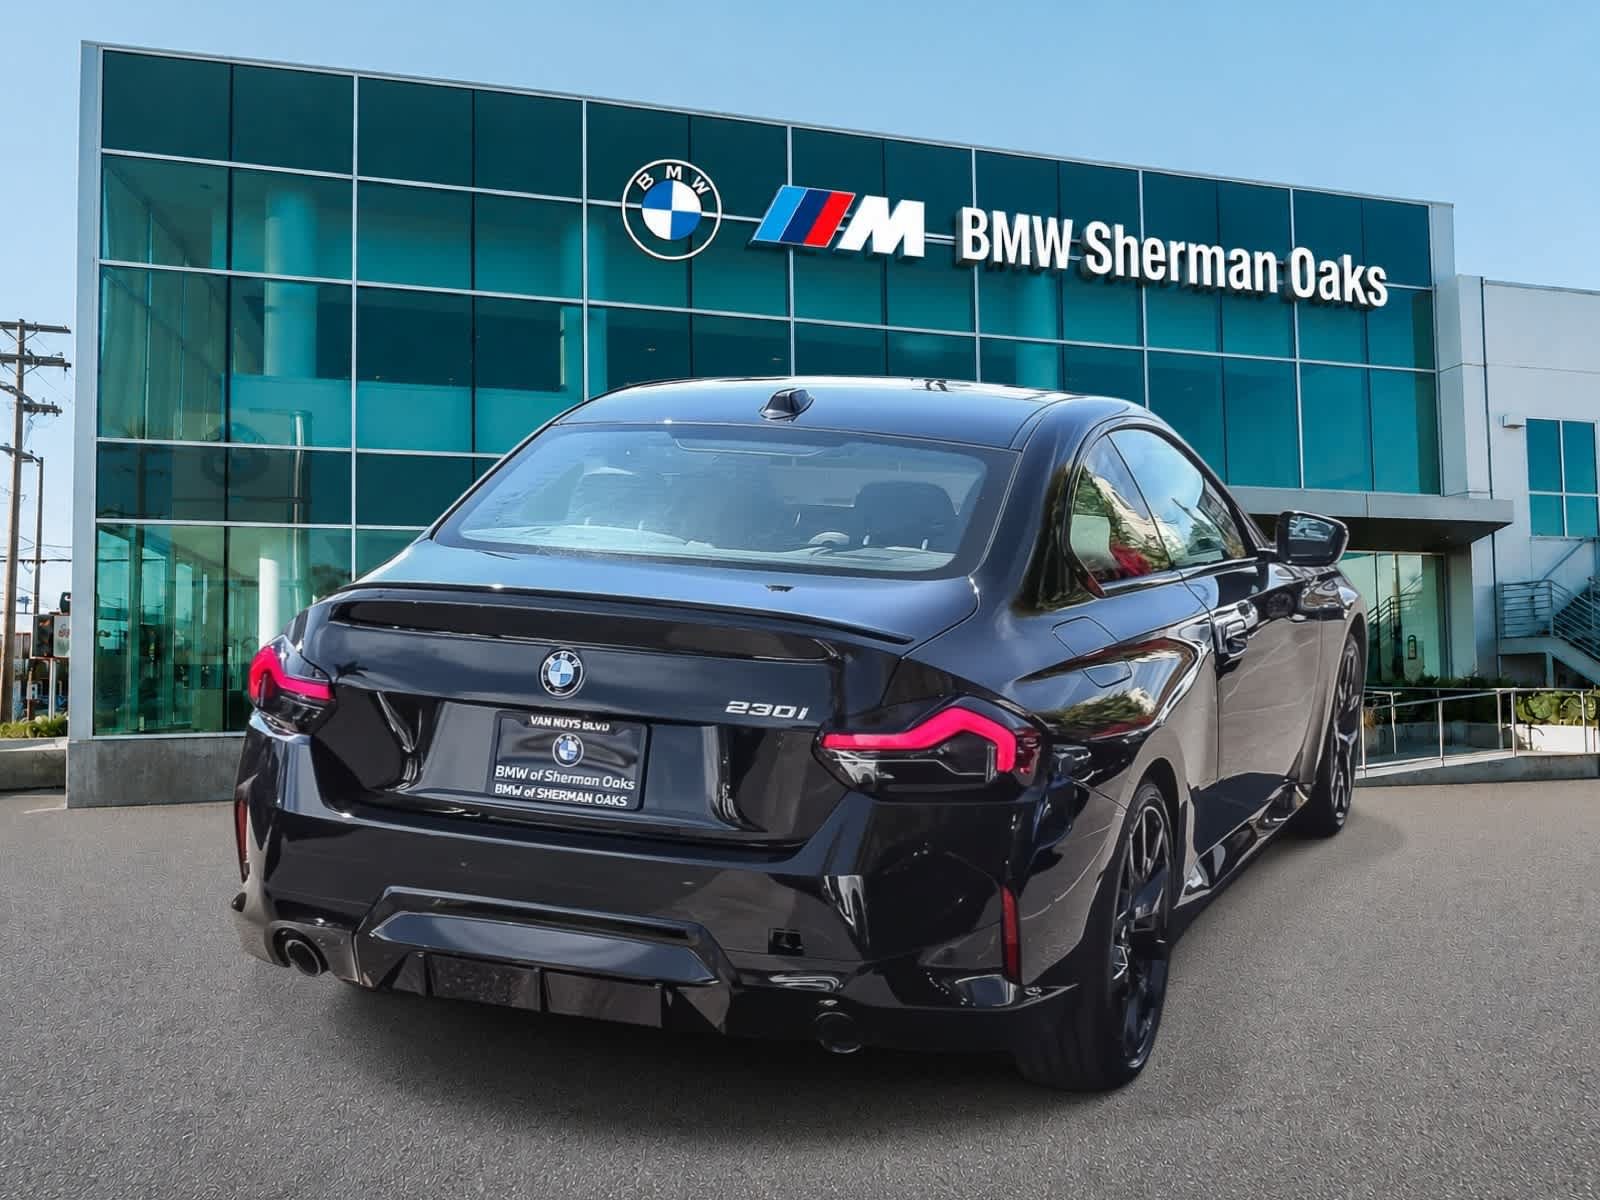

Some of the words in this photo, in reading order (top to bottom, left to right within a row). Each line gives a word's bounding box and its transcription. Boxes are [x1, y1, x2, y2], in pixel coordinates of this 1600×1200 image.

[636, 165, 712, 196] BMW
[959, 206, 1074, 270] BMW
[1084, 220, 1279, 294] Sherman
[1289, 246, 1388, 308] Oaks
[530, 715, 552, 727] VAN
[553, 718, 581, 729] NUYS
[582, 721, 610, 732] BLVD
[495, 765, 528, 779] BMW
[530, 768, 543, 780] of
[544, 770, 600, 786] Sherman
[602, 775, 635, 790] Oaks
[495, 783, 522, 796] BMW
[524, 786, 535, 797] of
[536, 787, 593, 803] SHERMAN
[595, 794, 627, 806] OAKS
